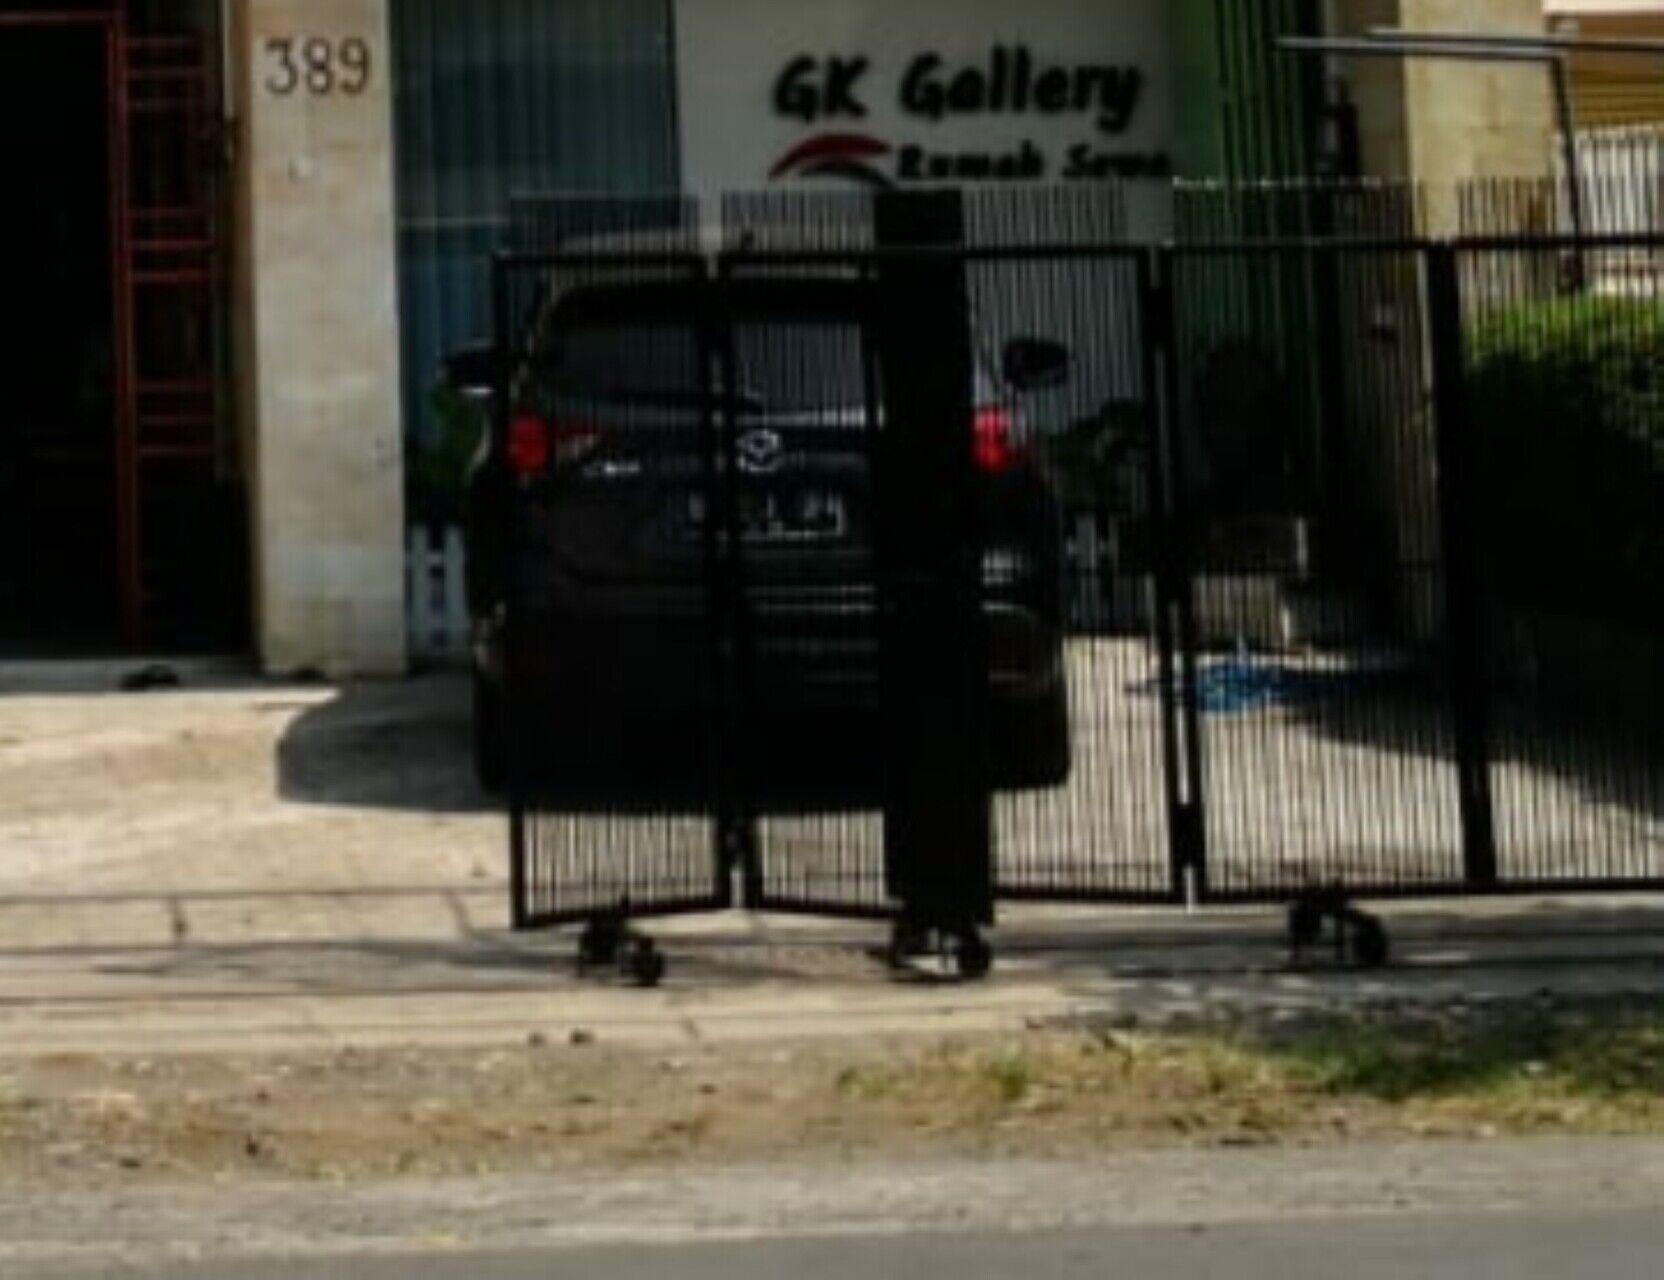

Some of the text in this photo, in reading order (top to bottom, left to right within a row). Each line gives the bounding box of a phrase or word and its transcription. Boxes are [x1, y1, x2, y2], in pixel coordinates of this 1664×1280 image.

[265, 36, 373, 98] 389
[773, 42, 1142, 133] GK Gallery
